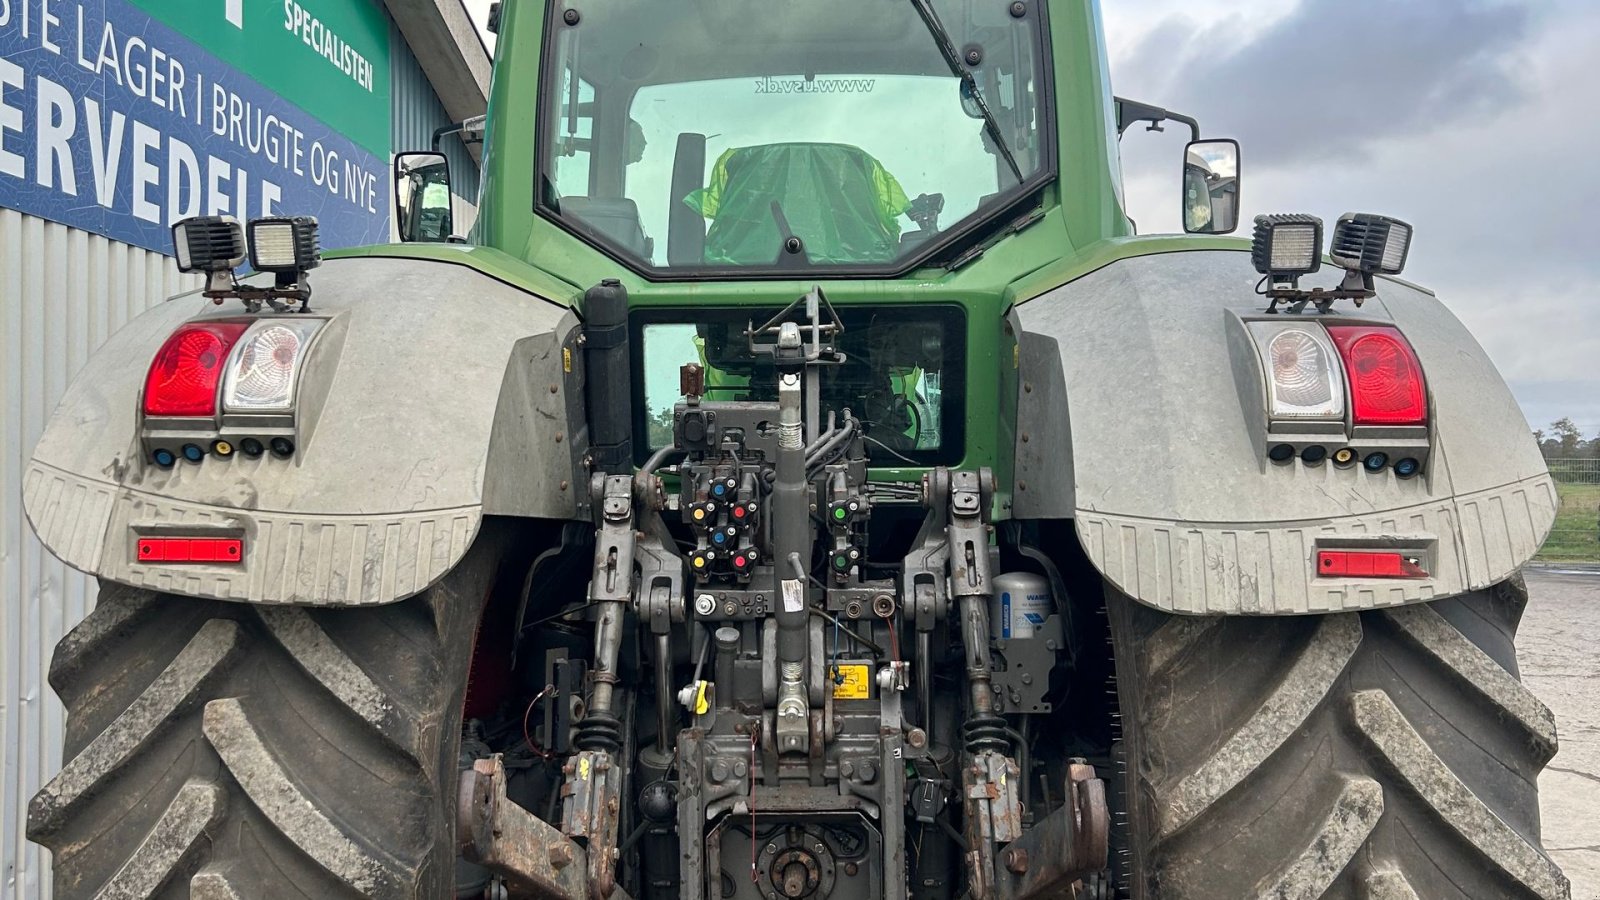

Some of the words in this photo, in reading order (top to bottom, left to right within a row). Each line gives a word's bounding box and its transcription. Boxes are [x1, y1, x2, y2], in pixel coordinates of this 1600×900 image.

[78, 5, 186, 117] LAGER
[197, 74, 202, 125] I
[213, 84, 303, 176] BRUGTE
[311, 142, 338, 193] OG
[345, 160, 376, 214] NYE
[285, 0, 373, 92] SPECIALISTEN
